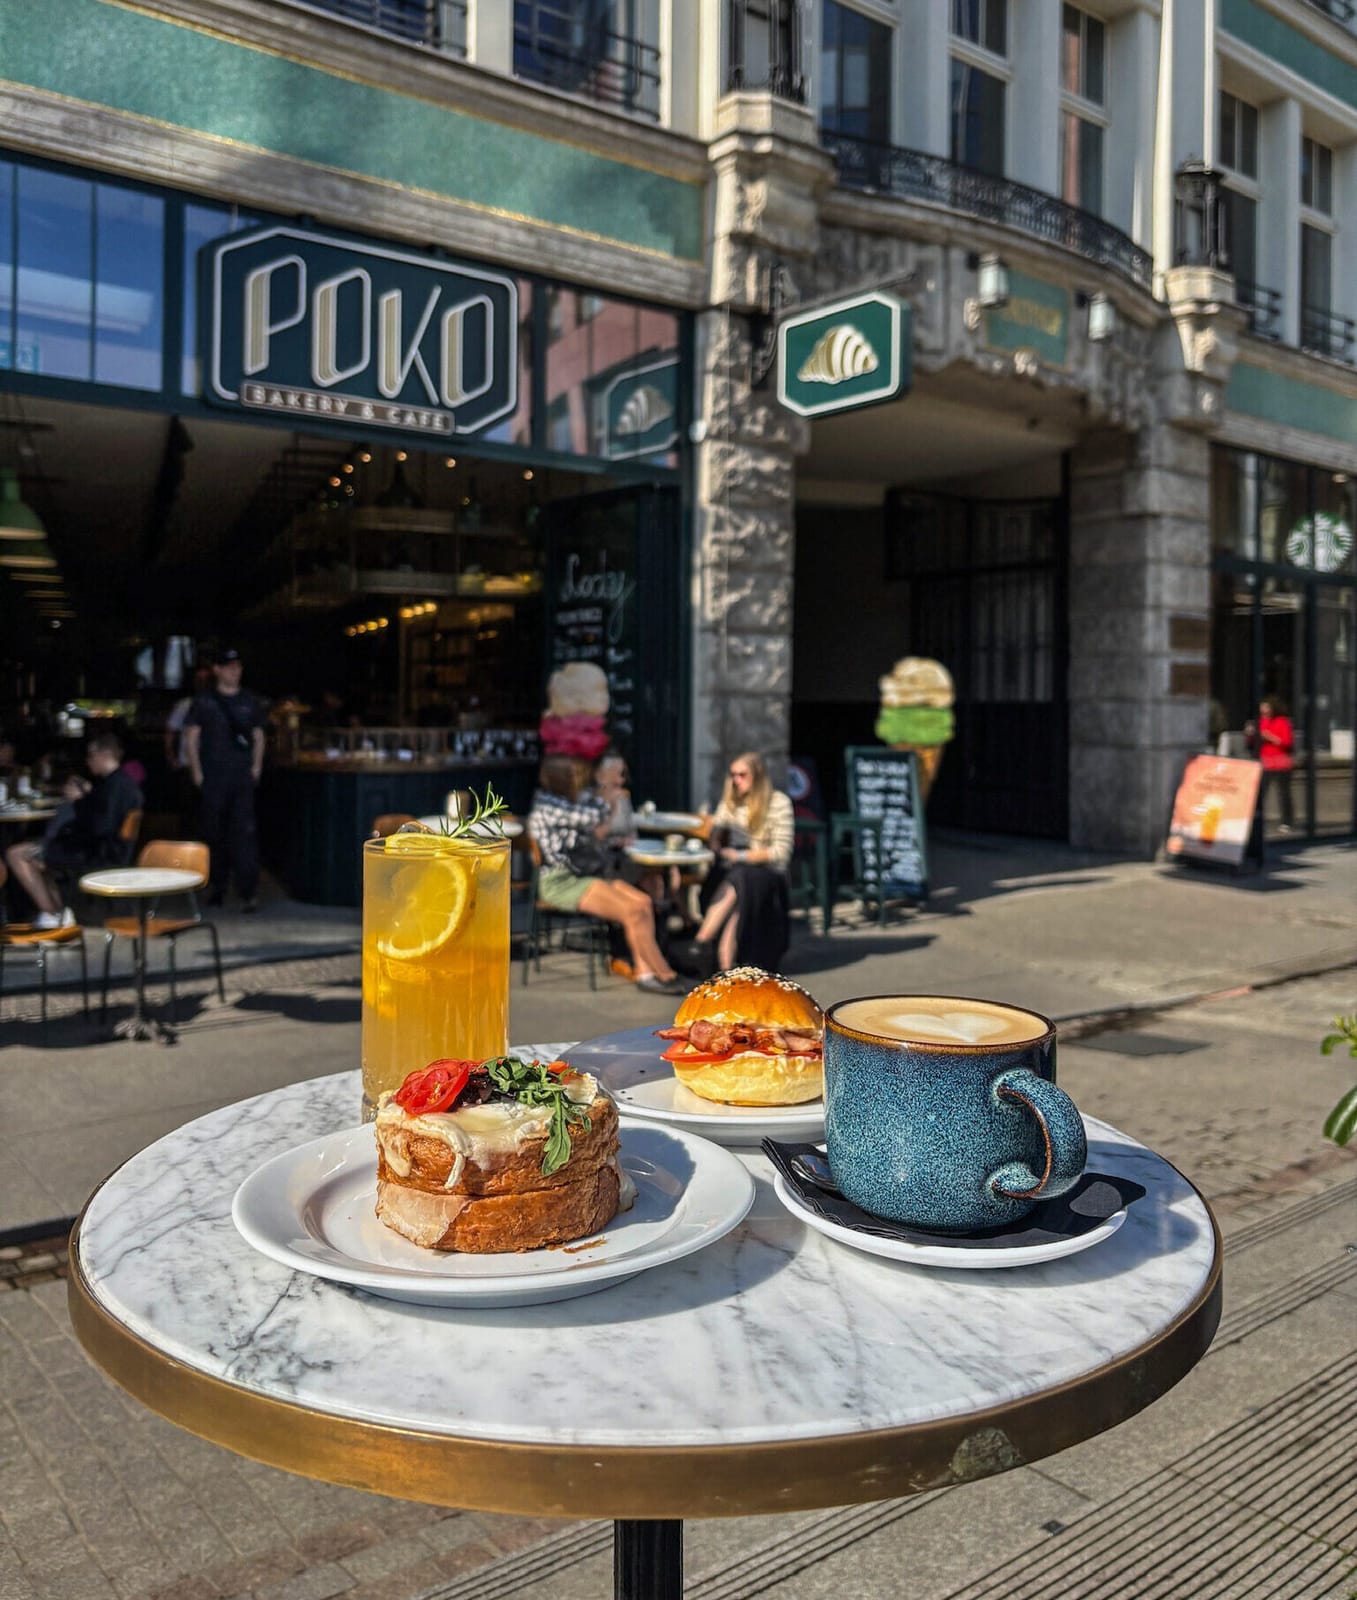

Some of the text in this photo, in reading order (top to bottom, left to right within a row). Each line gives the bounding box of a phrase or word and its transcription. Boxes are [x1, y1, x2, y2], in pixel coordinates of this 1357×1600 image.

[244, 254, 494, 408] POKO
[252, 385, 446, 430] BAKERY & CAFE
